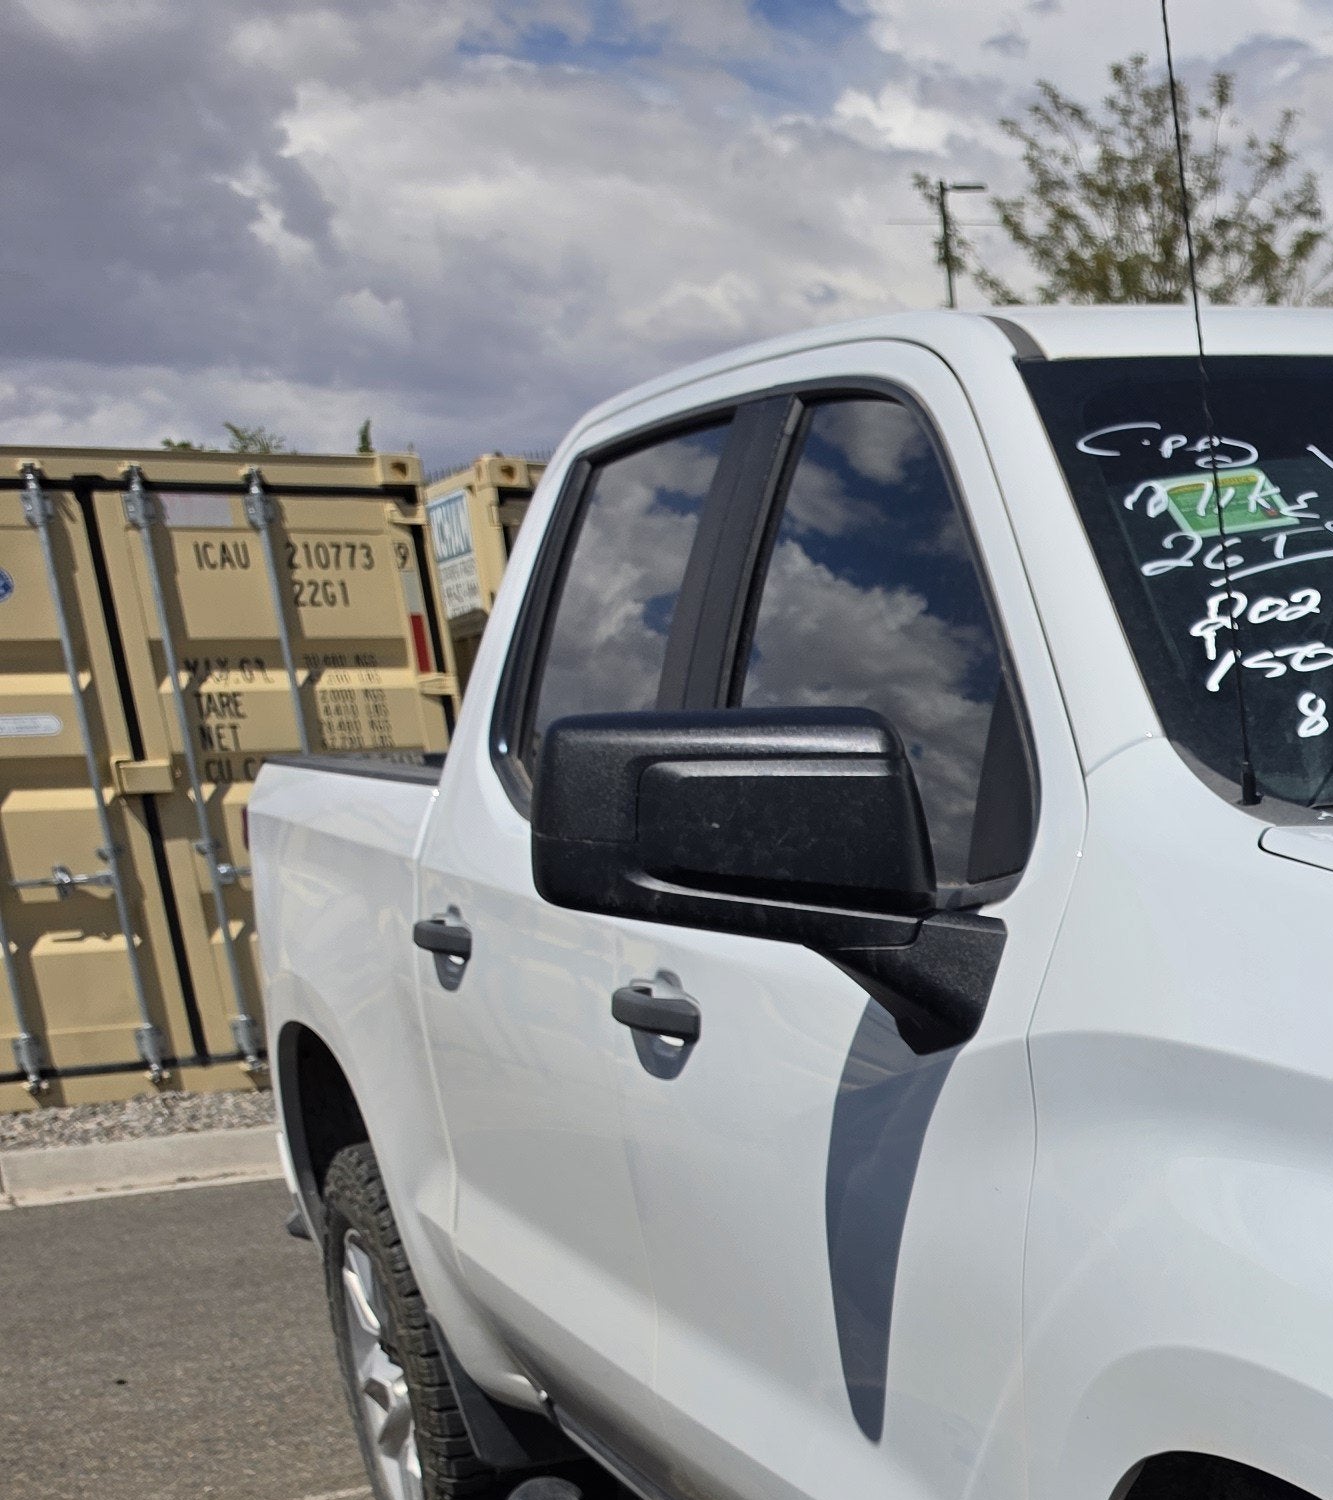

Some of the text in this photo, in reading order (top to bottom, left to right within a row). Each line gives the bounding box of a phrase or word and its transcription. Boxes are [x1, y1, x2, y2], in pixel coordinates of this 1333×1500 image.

[193, 541, 250, 570] ICAU
[286, 541, 375, 571] 210773
[293, 579, 350, 607] 22G1
